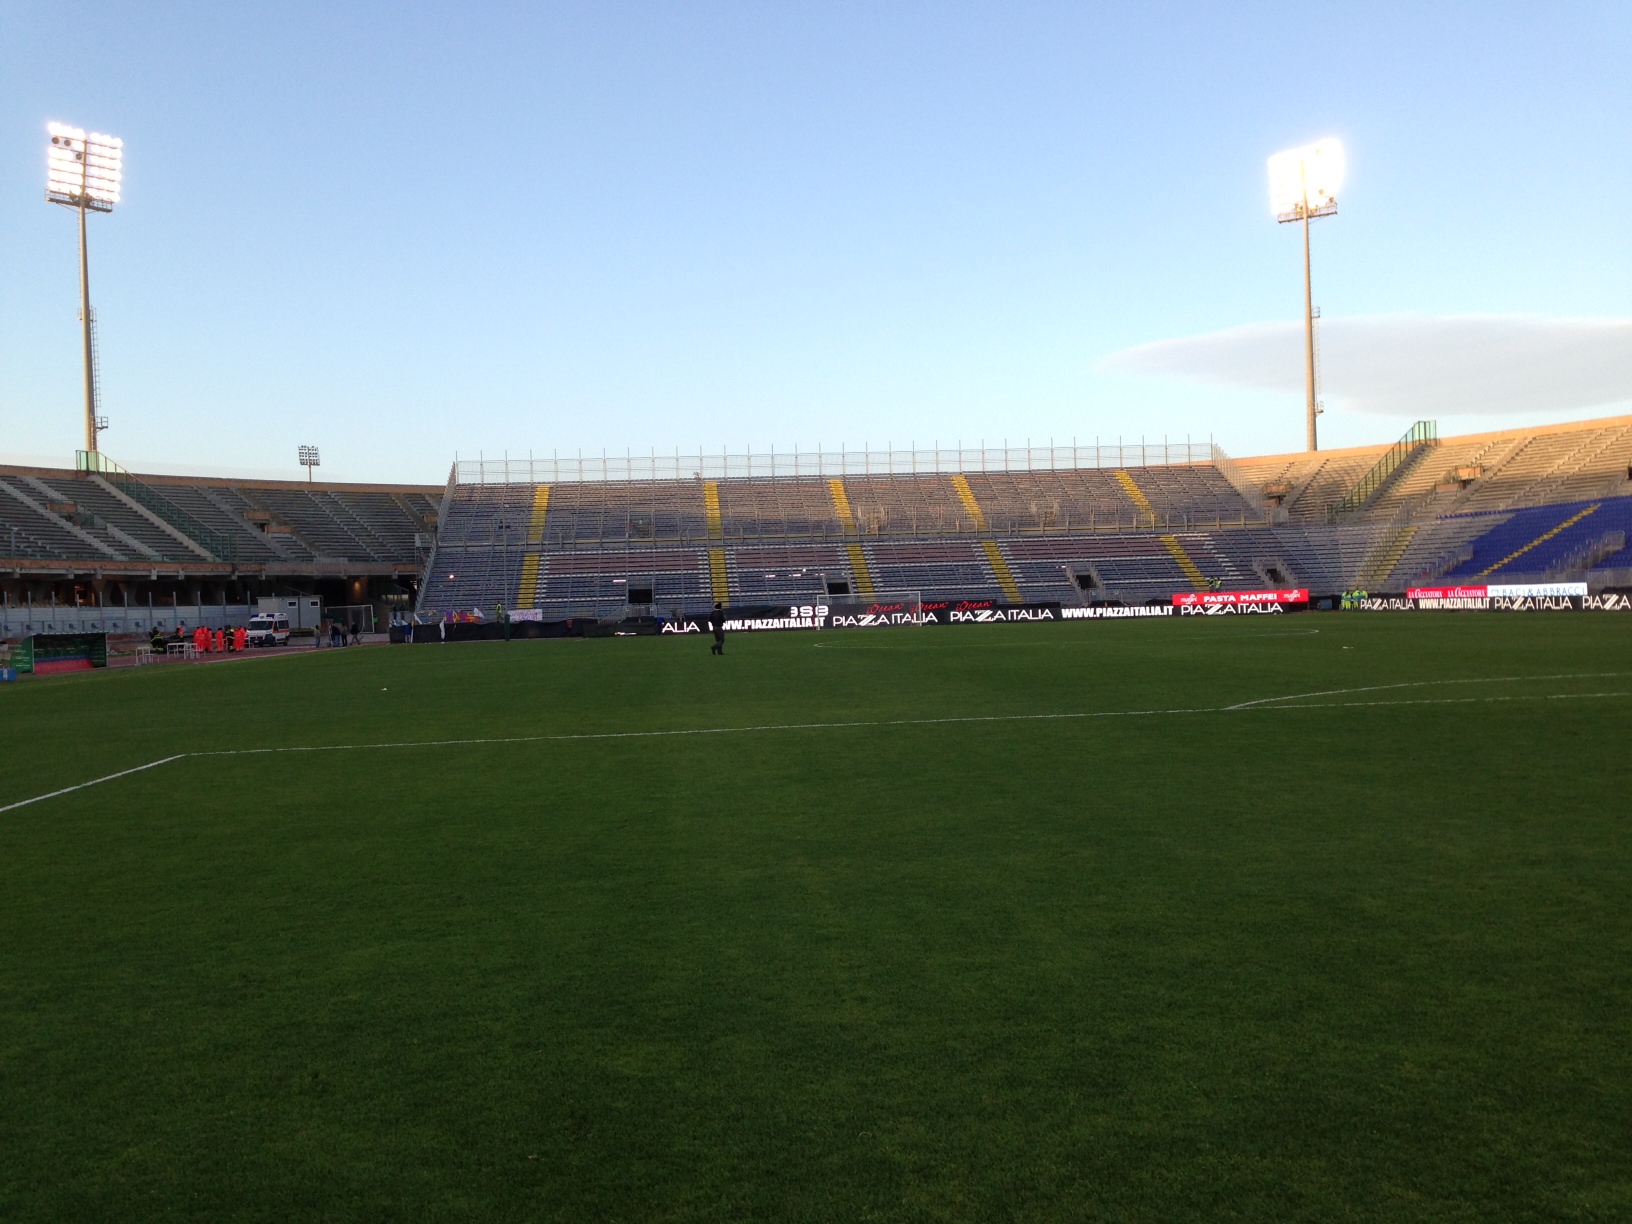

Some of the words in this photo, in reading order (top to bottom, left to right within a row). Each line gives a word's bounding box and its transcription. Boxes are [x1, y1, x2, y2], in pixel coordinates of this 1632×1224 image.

[1240, 593, 1277, 601] MAFFEI
[1536, 596, 1572, 610] ITALIA
[1237, 602, 1283, 614] ITALIA
[1389, 598, 1415, 610] ITALIA
[1419, 598, 1490, 610] WWW.PIAZZAITALIA.IT
[1008, 608, 1054, 621] ITALIA
[1061, 606, 1174, 618] WWW.PIAZZAITALIA.IT
[892, 612, 938, 625] ITALIA
[662, 621, 700, 633] ALIA
